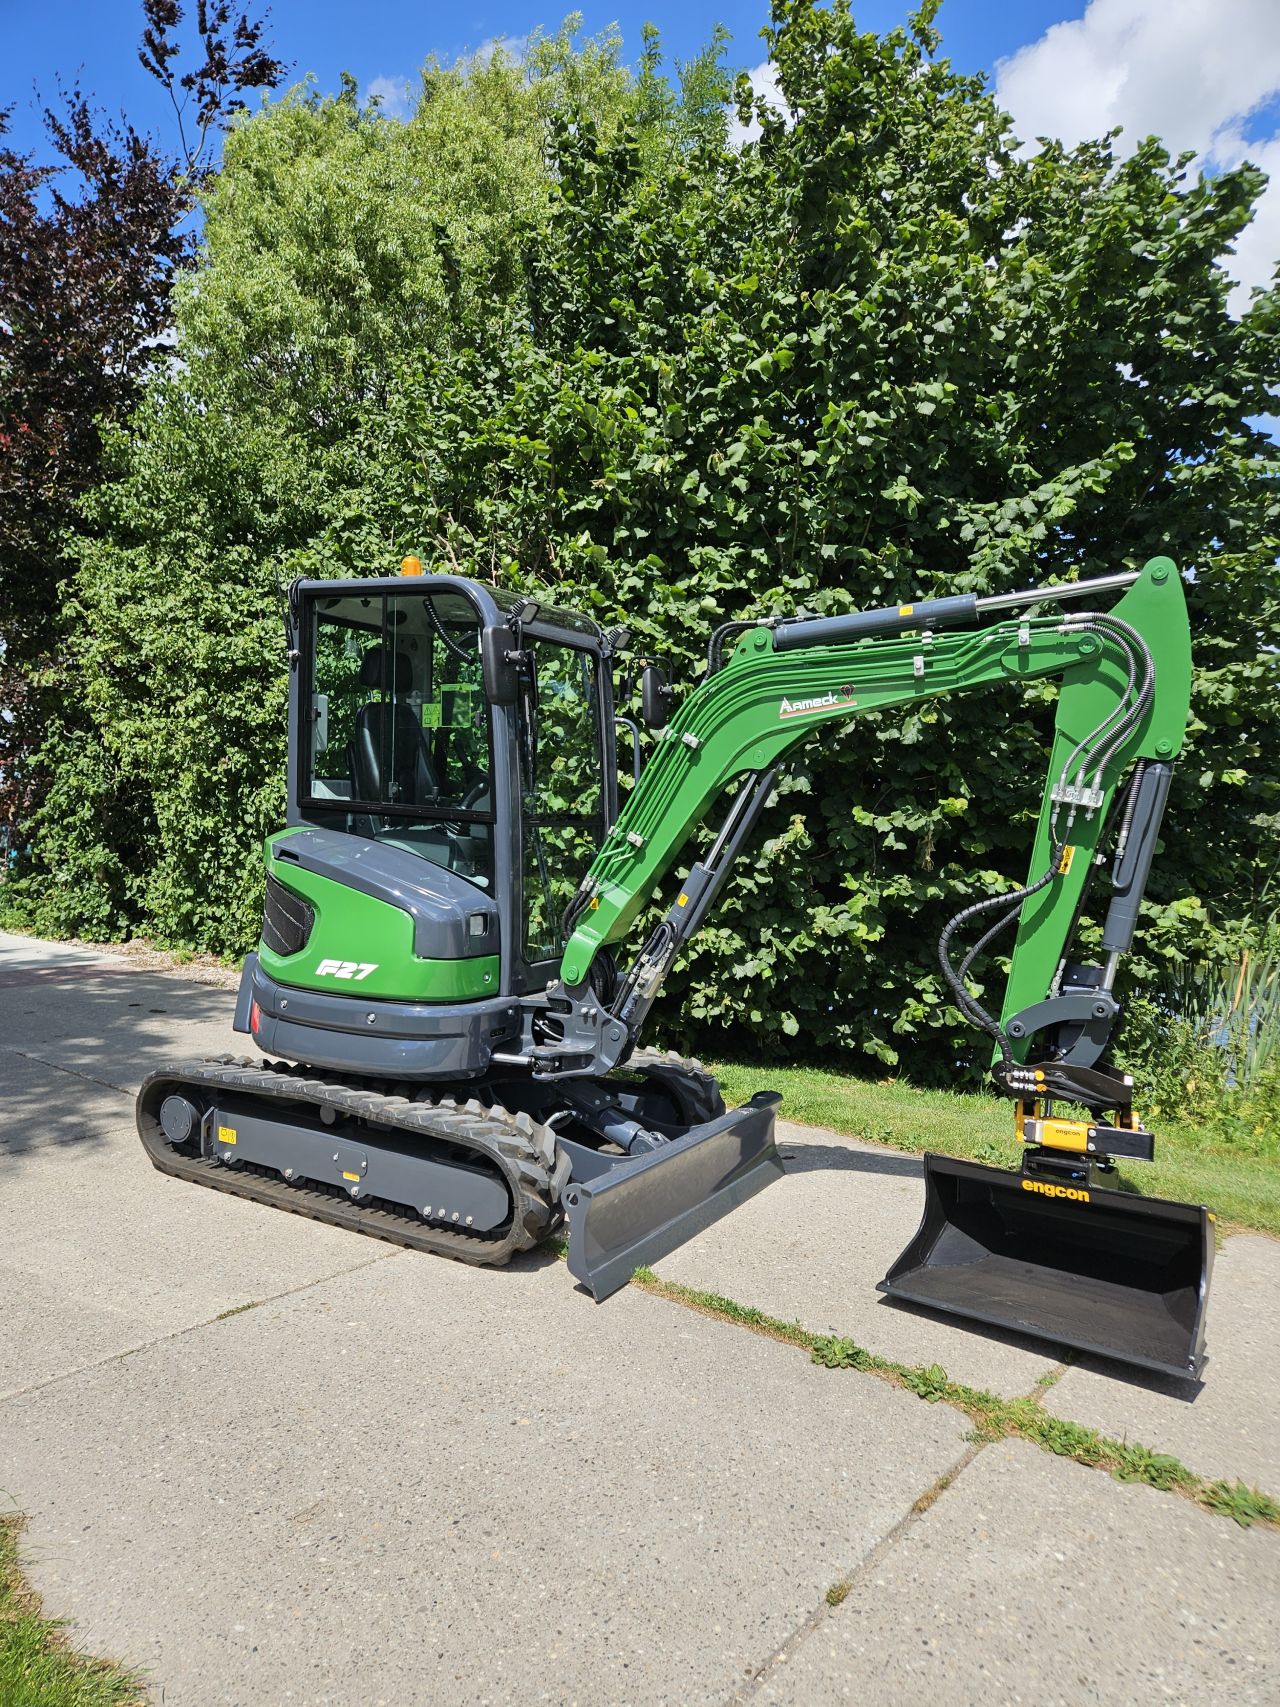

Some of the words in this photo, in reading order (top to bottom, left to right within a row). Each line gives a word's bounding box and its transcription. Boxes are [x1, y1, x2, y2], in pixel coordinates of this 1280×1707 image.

[315, 958, 379, 981] F27
[1055, 1129, 1081, 1137] engcon
[1021, 1179, 1090, 1203] engcon
